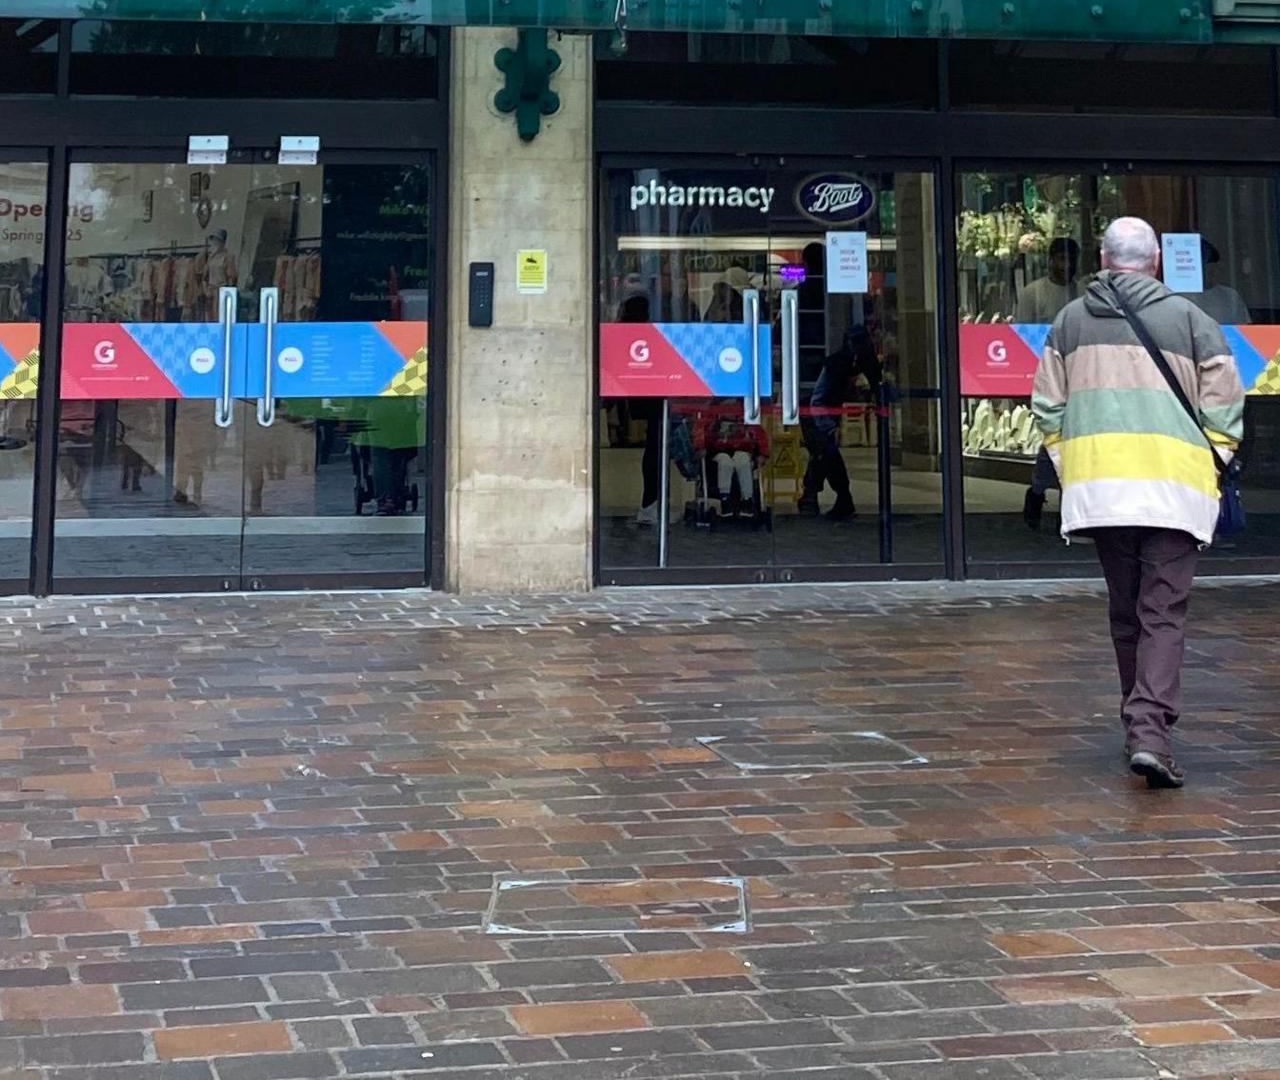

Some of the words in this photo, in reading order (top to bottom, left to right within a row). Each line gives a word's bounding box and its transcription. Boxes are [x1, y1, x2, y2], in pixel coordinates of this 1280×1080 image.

[630, 179, 774, 213] pharmacy
[808, 182, 863, 213] Boots
[2, 228, 43, 244] Spring
[94, 340, 116, 363] G
[629, 339, 650, 362] G
[987, 340, 1007, 362] G
